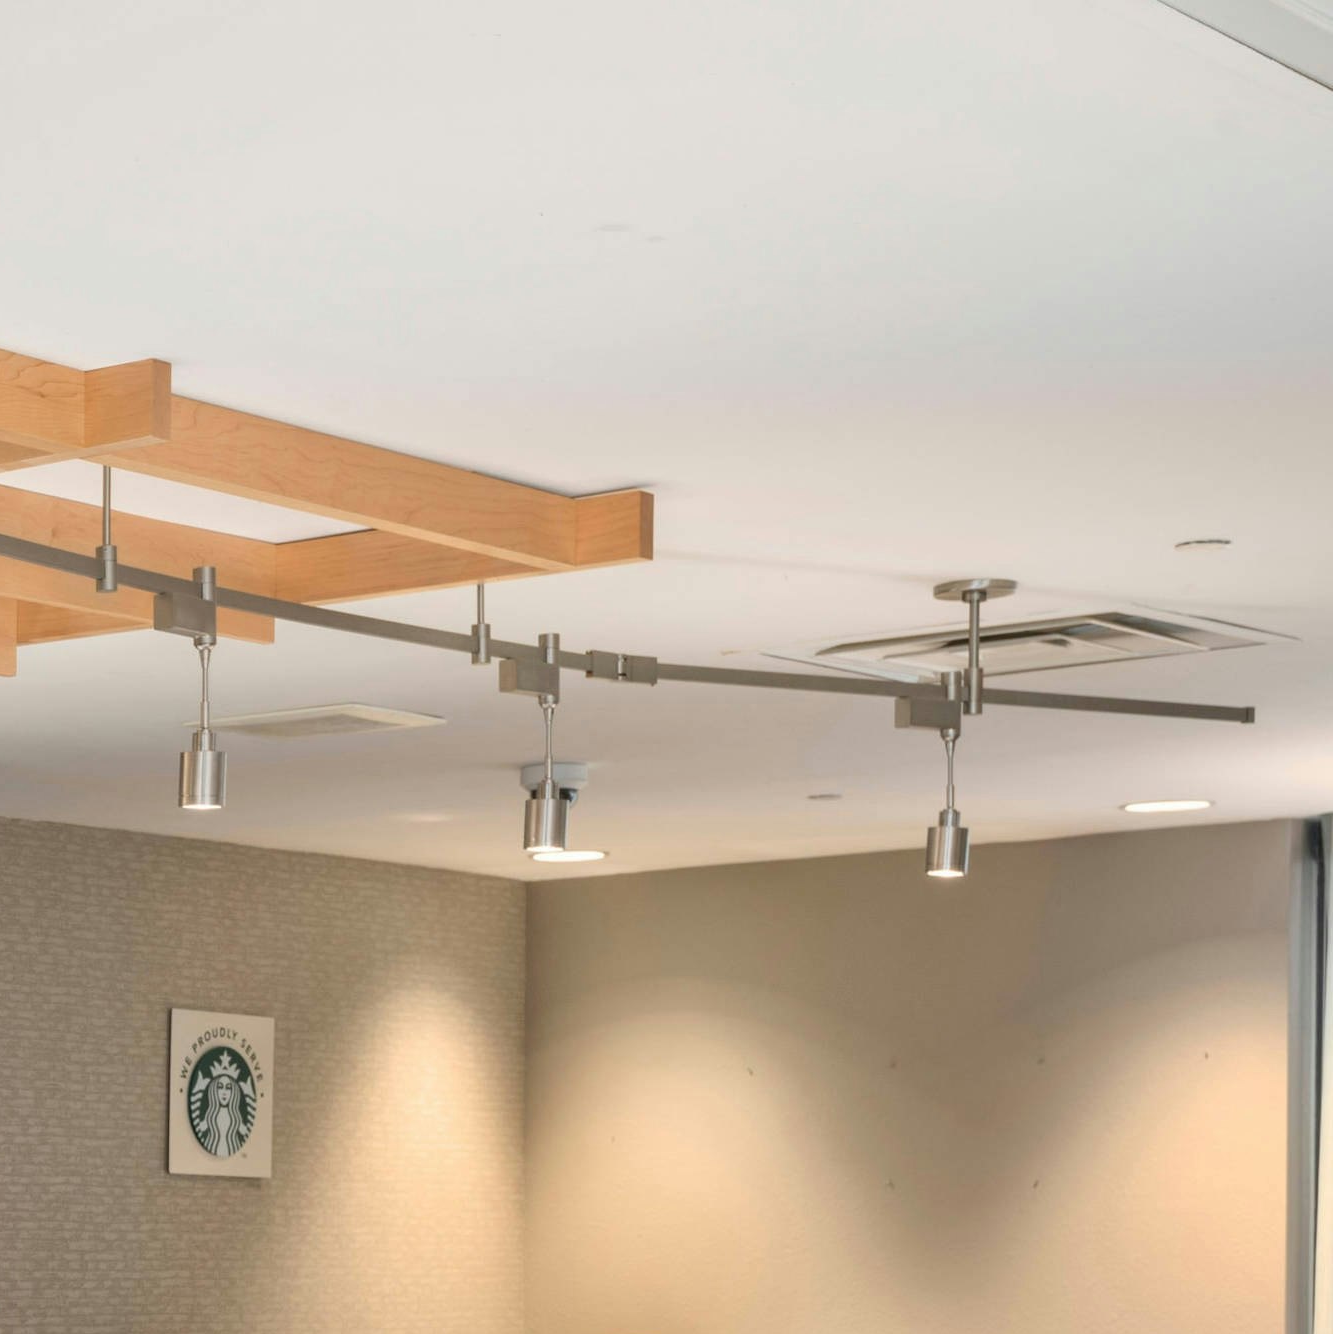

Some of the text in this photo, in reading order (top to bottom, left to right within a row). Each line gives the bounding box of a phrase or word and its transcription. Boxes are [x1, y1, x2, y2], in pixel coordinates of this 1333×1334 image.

[180, 1027, 264, 1082] WE PROUDLY SERVE
